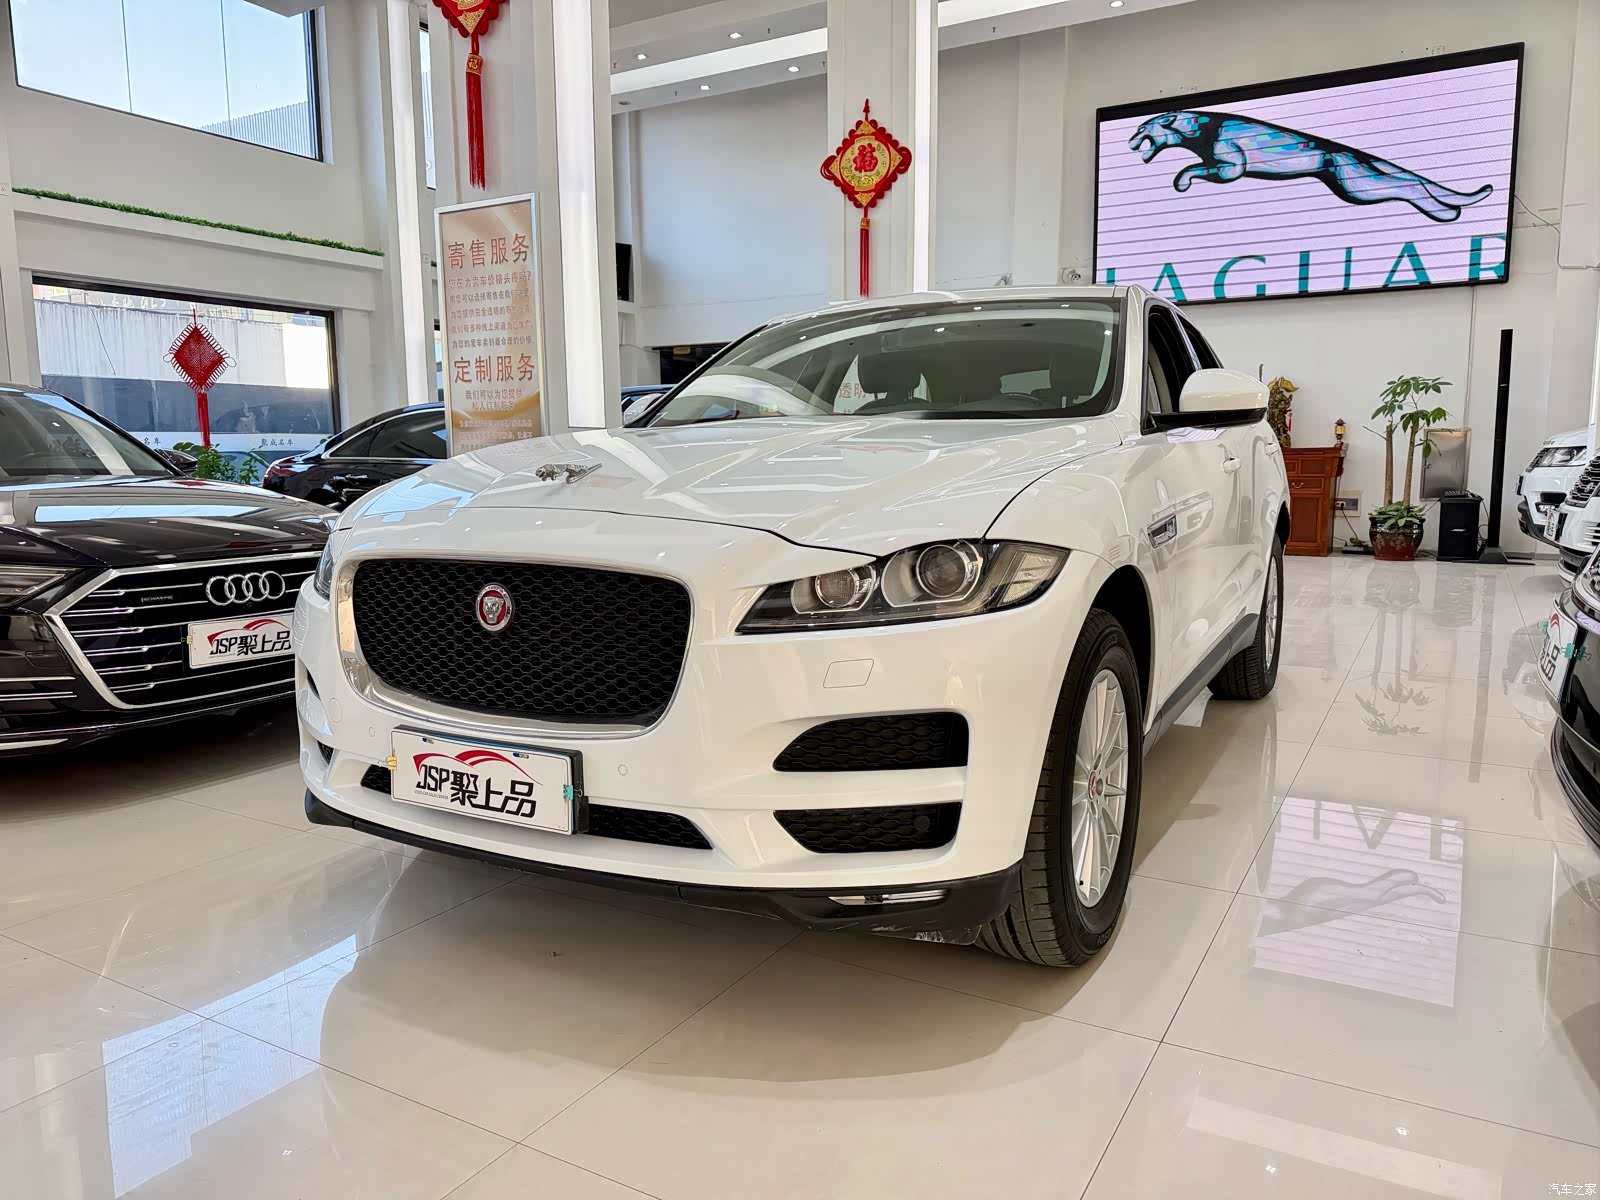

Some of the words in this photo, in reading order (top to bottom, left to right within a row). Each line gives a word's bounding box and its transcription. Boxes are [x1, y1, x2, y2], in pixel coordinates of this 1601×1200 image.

[853, 143, 878, 173] 福
[448, 233, 529, 269] 寄售服务
[454, 353, 535, 383] 定制服务
